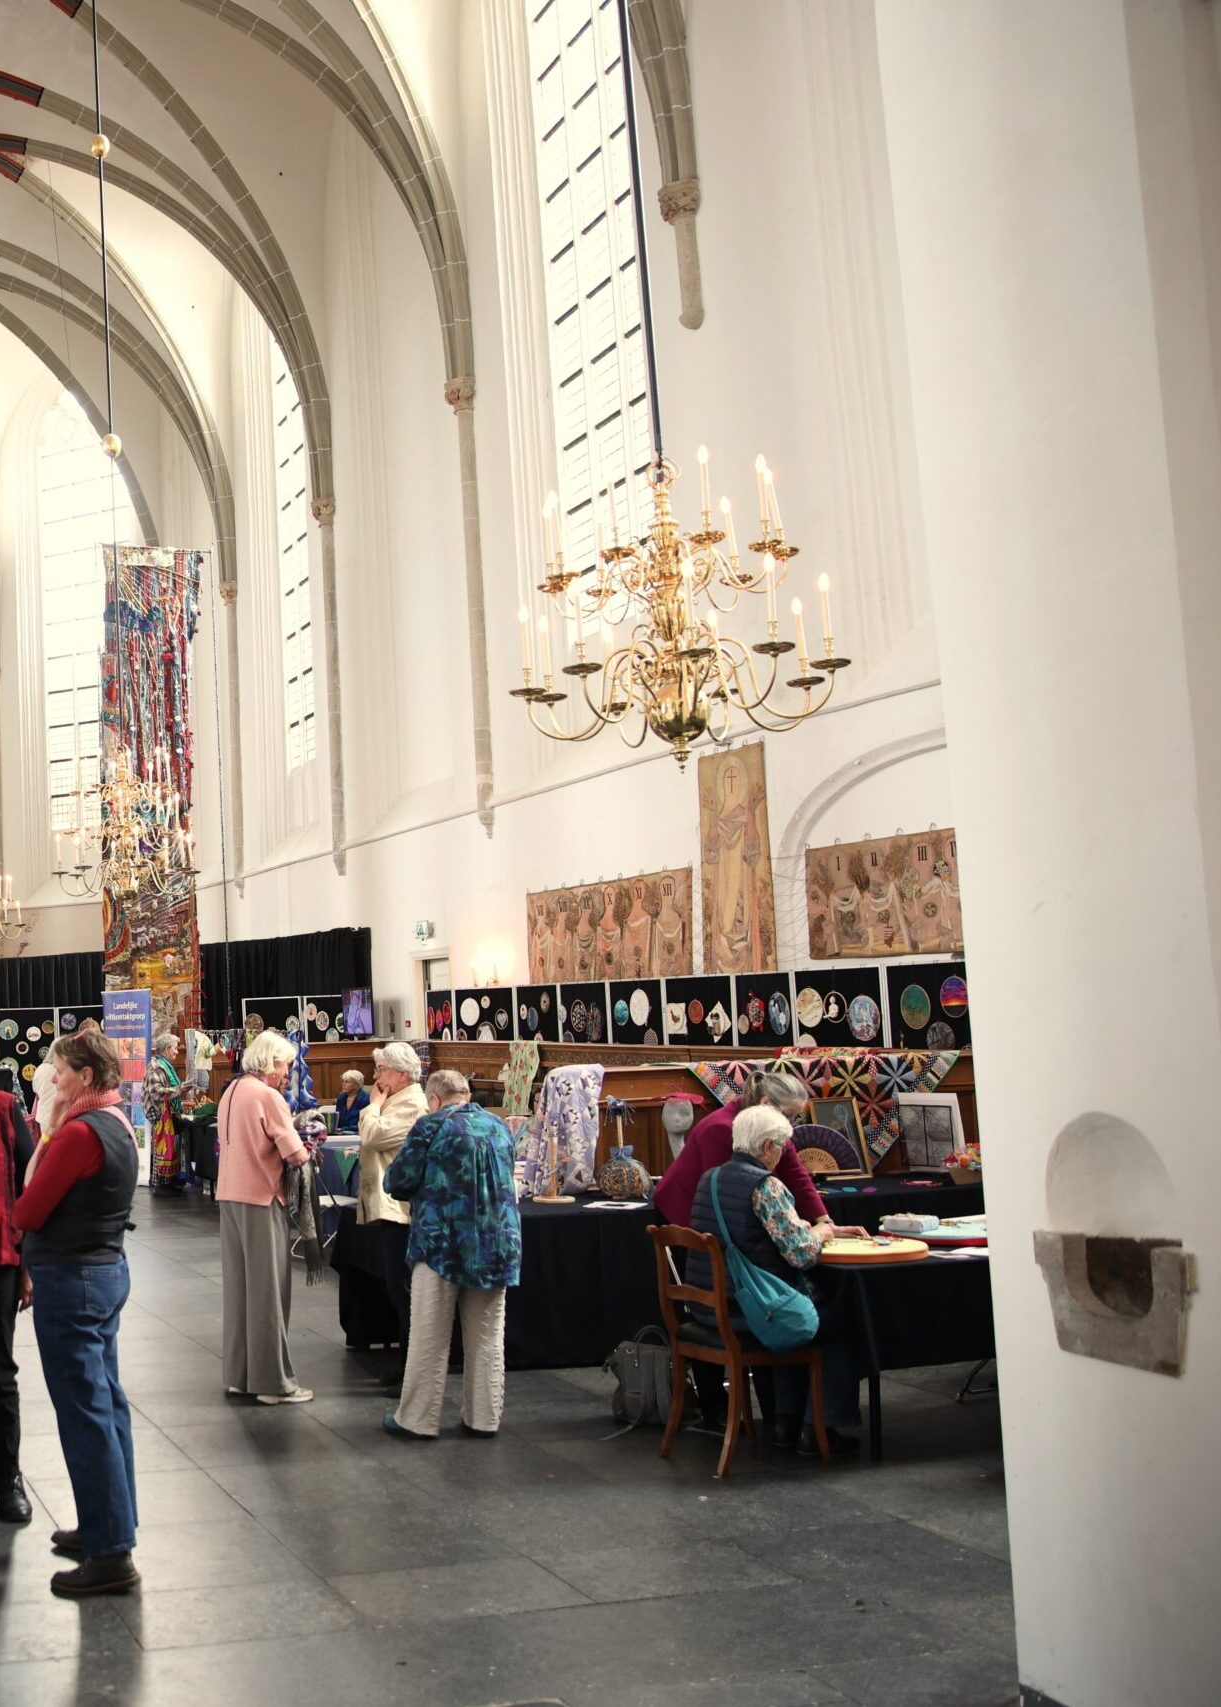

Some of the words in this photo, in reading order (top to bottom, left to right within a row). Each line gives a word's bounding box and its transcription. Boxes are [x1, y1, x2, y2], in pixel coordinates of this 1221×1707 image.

[870, 852, 878, 867] II
[917, 845, 928, 861] III
[836, 856, 841, 871] I
[635, 887, 643, 900] XI
[662, 883, 673, 897] XII
[606, 893, 613, 906] X
[113, 1001, 138, 1011] Landelijke
